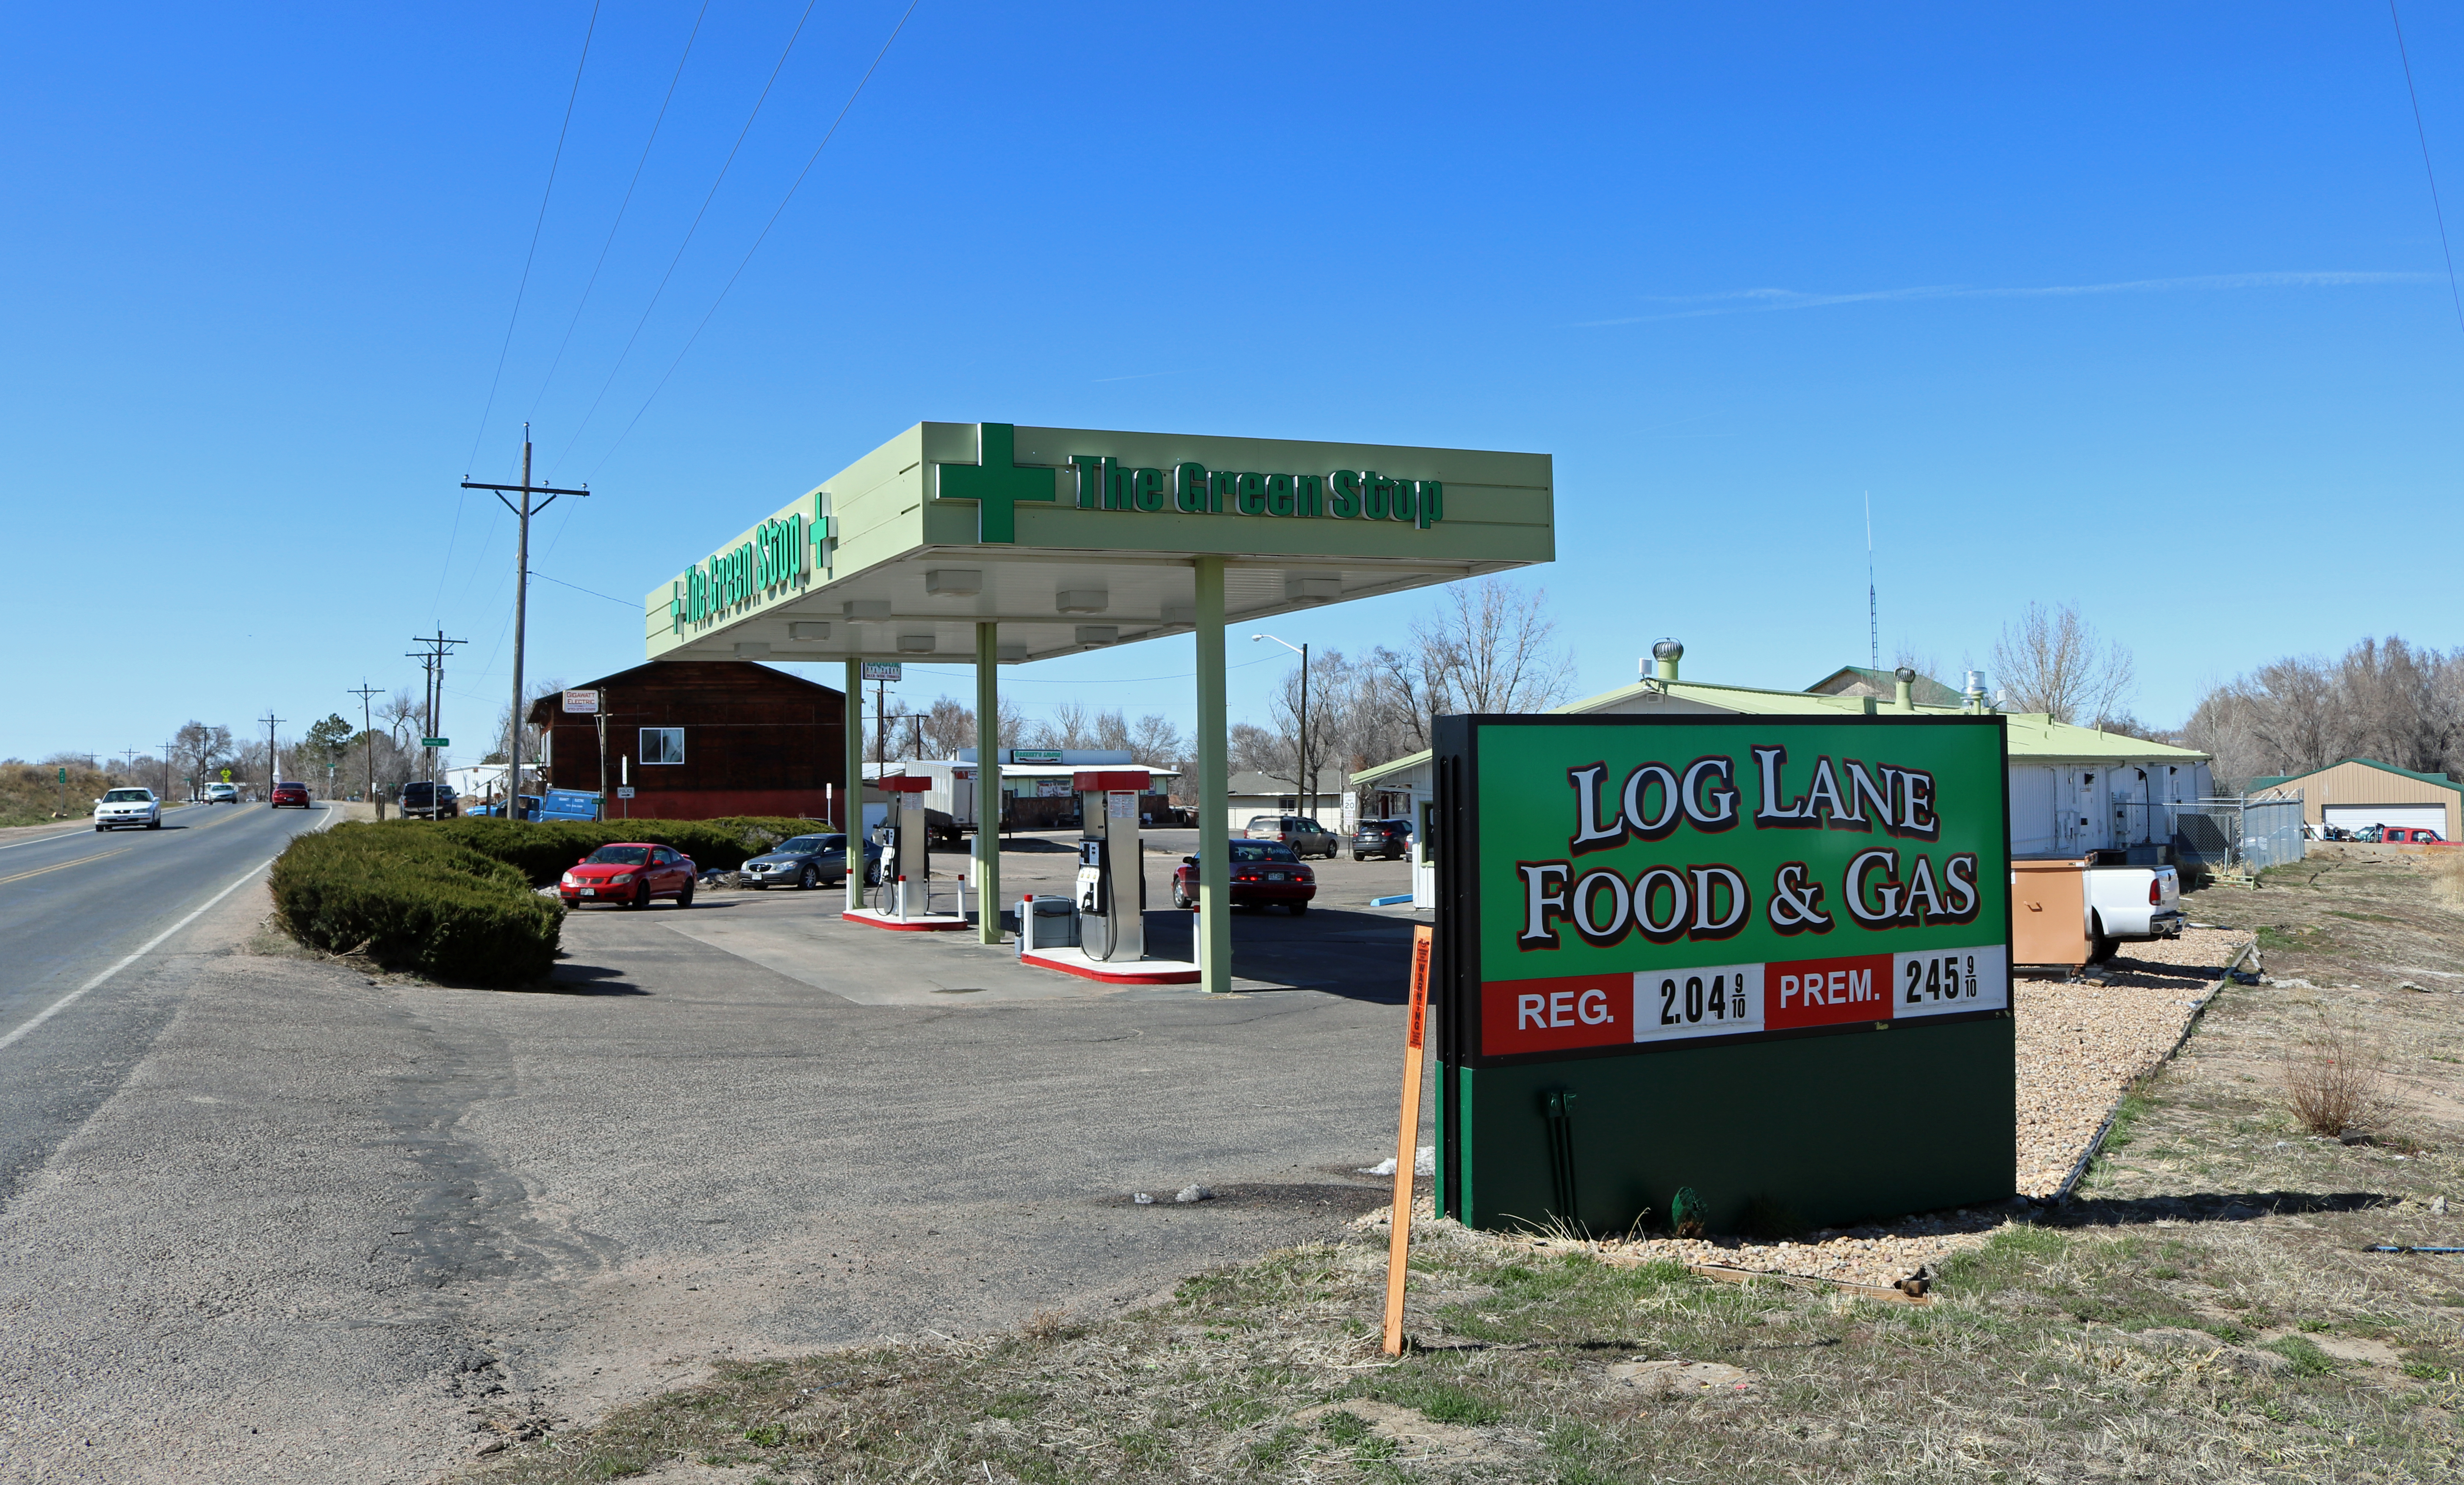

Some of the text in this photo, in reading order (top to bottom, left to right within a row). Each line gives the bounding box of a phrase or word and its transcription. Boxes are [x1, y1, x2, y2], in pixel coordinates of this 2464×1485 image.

[1069, 455, 1443, 529] The Green Stop
[685, 512, 805, 625] The Green Stop
[1570, 744, 1941, 856] LOG LANE
[1516, 847, 1981, 952] FOOD & GAS
[1414, 963, 1425, 1030] WARNING
[1518, 989, 1614, 1030] REG.
[1661, 975, 1726, 1025] 2.04
[1780, 969, 1880, 1009] PREM.
[1906, 957, 1959, 1004] 245
